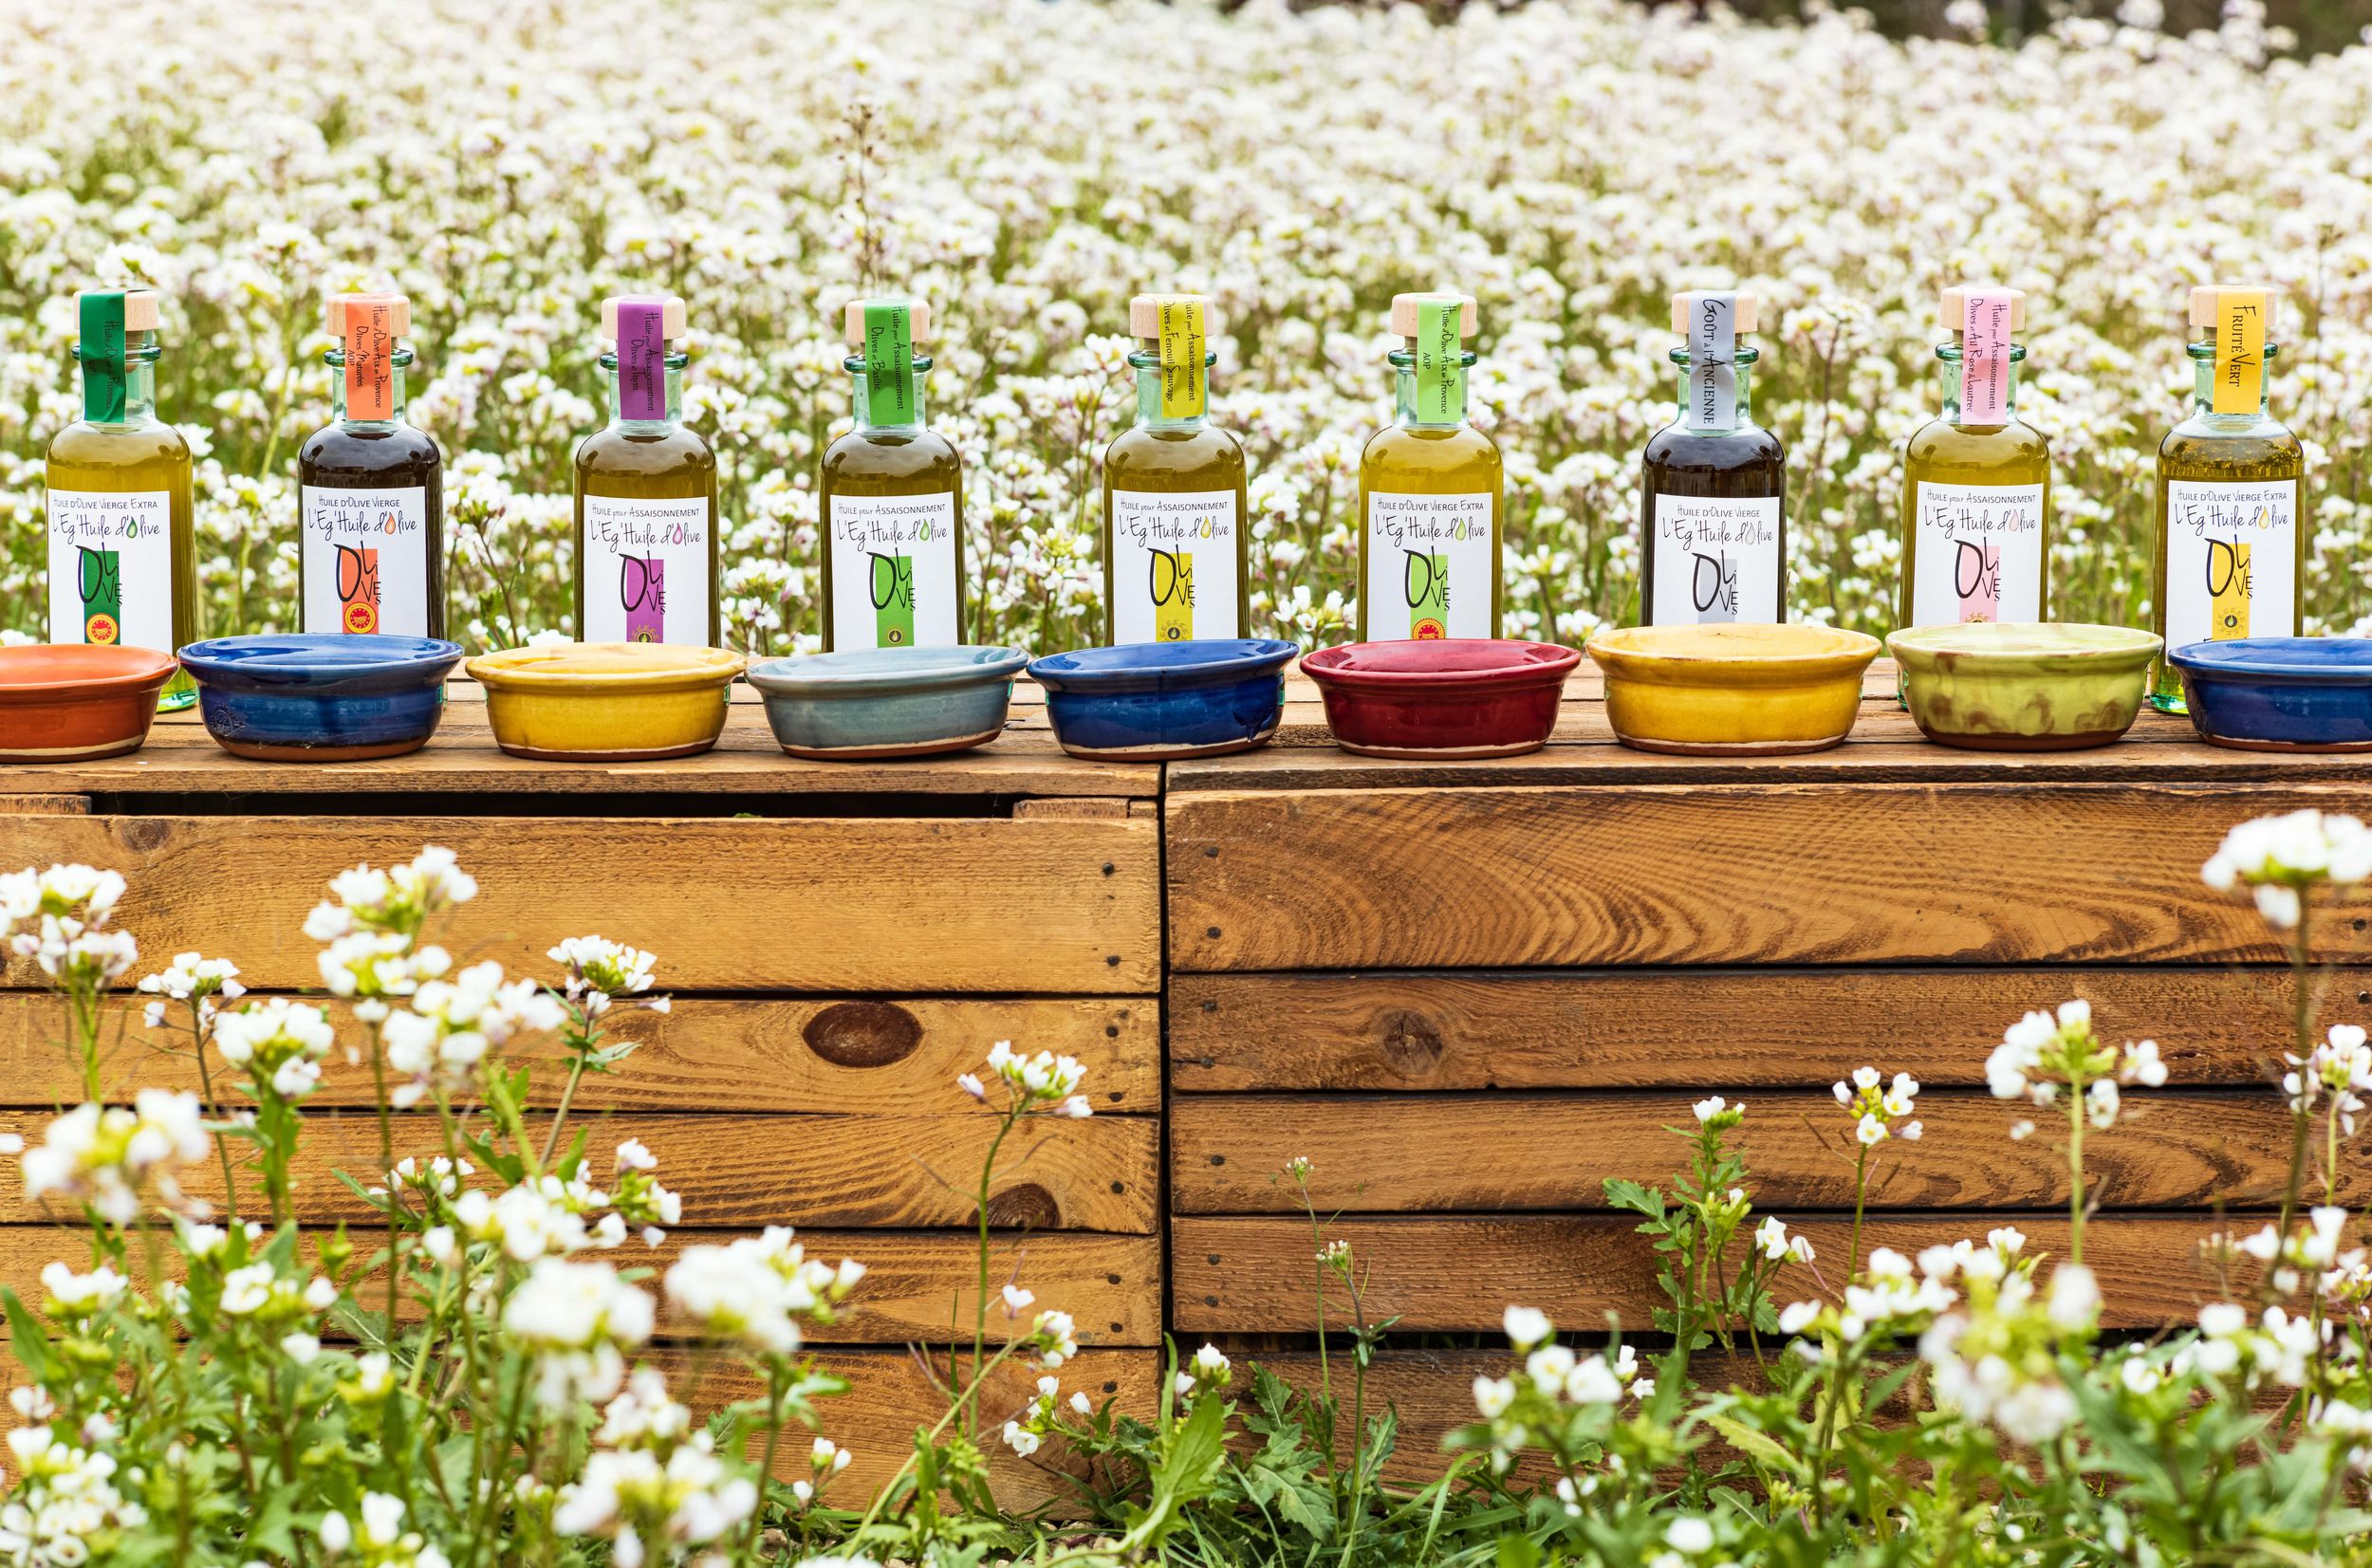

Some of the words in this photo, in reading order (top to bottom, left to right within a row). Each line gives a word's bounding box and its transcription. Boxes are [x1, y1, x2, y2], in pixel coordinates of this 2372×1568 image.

[373, 305, 387, 326] Huile
[645, 312, 659, 334] Huile
[892, 305, 906, 329] Huile
[1442, 304, 1456, 327] Huile
[1703, 299, 1727, 341] GOÛT
[1970, 298, 1984, 324] Olives
[1992, 304, 2008, 327] Huile
[104, 321, 120, 342] Huile
[357, 326, 369, 349] Olives
[871, 326, 884, 356] Olives
[1969, 333, 1983, 346] Ail
[2232, 305, 2256, 353] FRUITÉ
[631, 340, 645, 364] Olives
[1165, 332, 1179, 364] Fenouil
[1969, 347, 1983, 372] Rose
[357, 350, 370, 387] Maturées
[373, 353, 386, 369] Aix
[1187, 333, 1201, 401] Assaisonnement
[1440, 355, 1455, 373] Aix
[2230, 353, 2255, 387] VERT
[630, 368, 646, 391] Thym
[645, 349, 659, 412] Assaisonnement
[872, 360, 885, 391] Basilic
[893, 341, 907, 410] Assaisonnement
[1165, 364, 1180, 402] Sauvage
[1989, 341, 2006, 410] Assaisonnement
[106, 372, 121, 410] Provence
[375, 374, 388, 408] Provence
[1440, 378, 1455, 414] Provence
[1967, 379, 1981, 413] Lautrec
[99, 498, 127, 509] VIERGE
[131, 498, 158, 508] EXTRA
[319, 495, 338, 507] HUILE
[372, 496, 399, 507] VIERGE
[1121, 498, 1139, 509] HUILE
[1140, 505, 1155, 515] pour
[1158, 501, 1228, 511] ASSAISONNEMENT
[1378, 498, 1397, 509] HUILE
[1430, 500, 1457, 510] VIERGE
[1461, 500, 1484, 509] EXTRA
[1927, 489, 1947, 501] HUILE
[1950, 496, 1964, 506] pour
[1966, 493, 2036, 503] ASSAISONNEMENT
[2177, 489, 2197, 501] HUILE
[2233, 490, 2261, 501] VIERGE
[2264, 489, 2287, 500] EXTRA
[592, 504, 611, 515] HUILE
[613, 510, 626, 520] pour
[629, 507, 699, 517] ASSAISONNEMENT
[838, 503, 857, 514] HUILE
[860, 509, 872, 519] pour
[876, 504, 945, 514] ASSAISONNEMENT
[1677, 505, 1699, 516] HUILE
[1735, 506, 1760, 517] VIERGE
